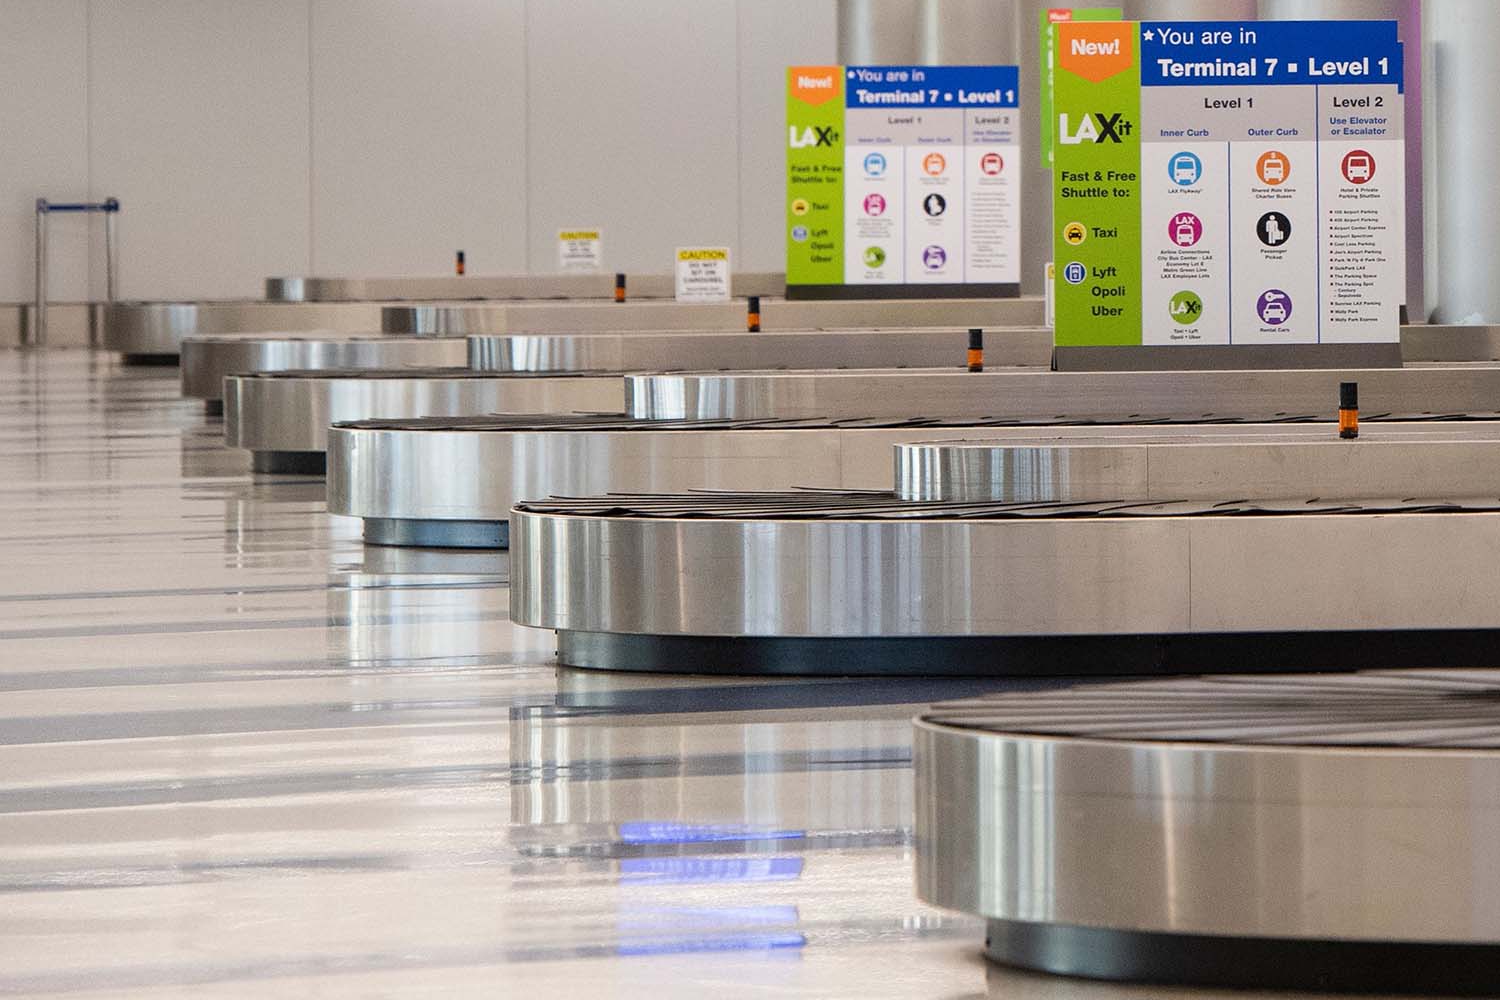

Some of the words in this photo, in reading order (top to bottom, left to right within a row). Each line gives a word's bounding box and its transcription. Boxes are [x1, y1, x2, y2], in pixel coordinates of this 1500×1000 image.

[1157, 28, 1194, 45] You
[1201, 32, 1233, 44] are
[1239, 28, 1257, 44] in
[1071, 38, 1120, 56] New!
[1157, 58, 1257, 77] Terminal
[1264, 58, 1279, 77] 7
[1308, 57, 1369, 76] Level
[1378, 57, 1388, 76] 1
[798, 75, 832, 89] New!
[856, 70, 881, 82] You
[886, 72, 908, 82] are
[912, 70, 925, 82] in
[856, 90, 925, 104] Terminal
[928, 90, 940, 104] 7
[958, 90, 1001, 104] Level
[1006, 90, 1015, 104] 1
[1333, 96, 1369, 108] Level
[1374, 96, 1384, 108] 2
[1204, 98, 1241, 109] Level
[1247, 98, 1253, 109] 1
[1329, 116, 1347, 125] Use
[1350, 116, 1388, 125] Elevator
[1160, 129, 1185, 137] Inner
[1187, 129, 1210, 137] Curb
[1247, 128, 1274, 136] Outer
[1276, 128, 1299, 136] Curb
[1330, 128, 1341, 136] or
[1343, 127, 1387, 136] Escalator
[1061, 170, 1090, 182] Fast
[1093, 170, 1103, 182] &
[1106, 170, 1137, 182] Free
[1061, 186, 1109, 198] Shuttle
[1112, 187, 1130, 198] to:
[1175, 216, 1195, 225] LAX
[1091, 227, 1118, 239] Taxi
[680, 250, 726, 260] CAUTION
[1092, 267, 1117, 280] Lyft
[1091, 285, 1126, 299] Opoli
[1091, 305, 1124, 318] Uber
